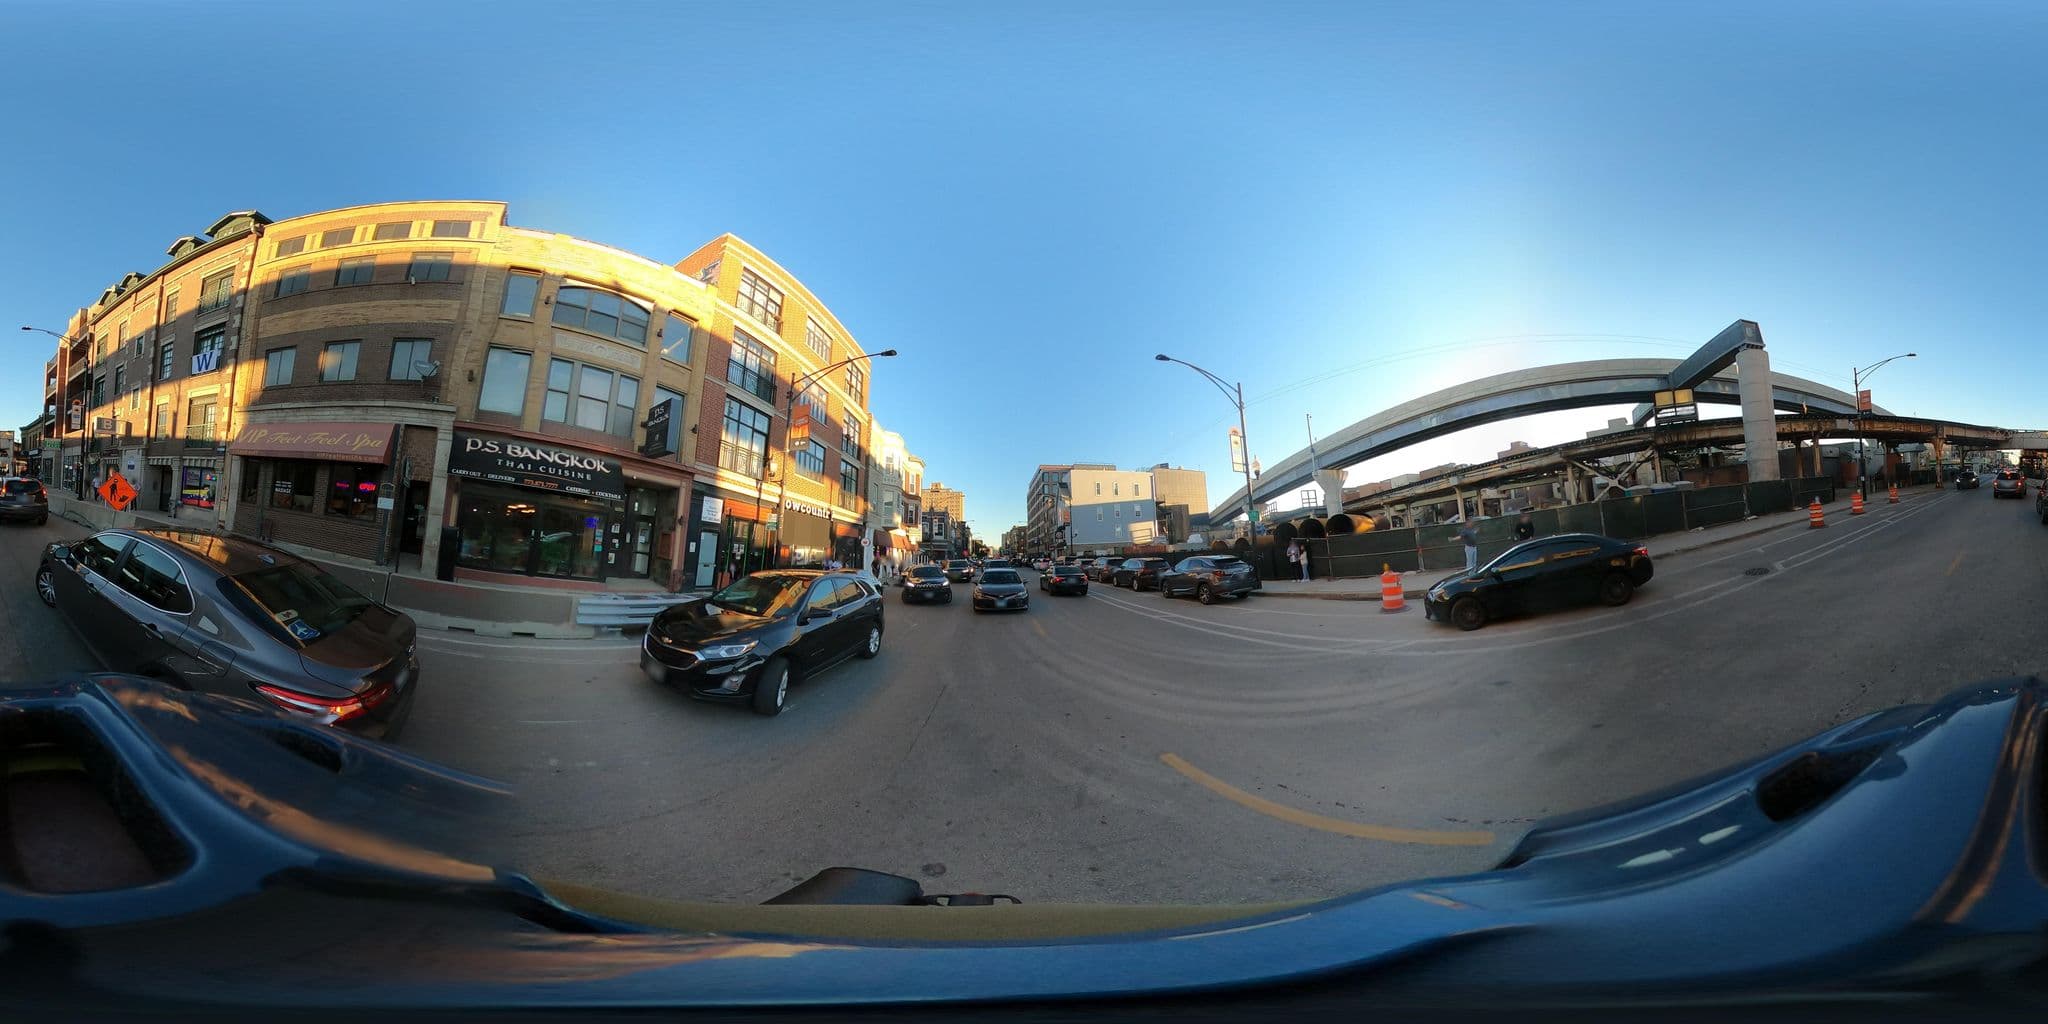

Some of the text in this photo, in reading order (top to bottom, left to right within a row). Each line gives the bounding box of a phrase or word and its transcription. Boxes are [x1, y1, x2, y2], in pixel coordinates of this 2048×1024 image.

[196, 352, 213, 372] W
[239, 429, 268, 443] VIP
[304, 432, 347, 446] Feel
[347, 433, 385, 452] Spa
[465, 437, 611, 474] P.S. BANGKOK
[496, 458, 593, 481] THAI CUISINE
